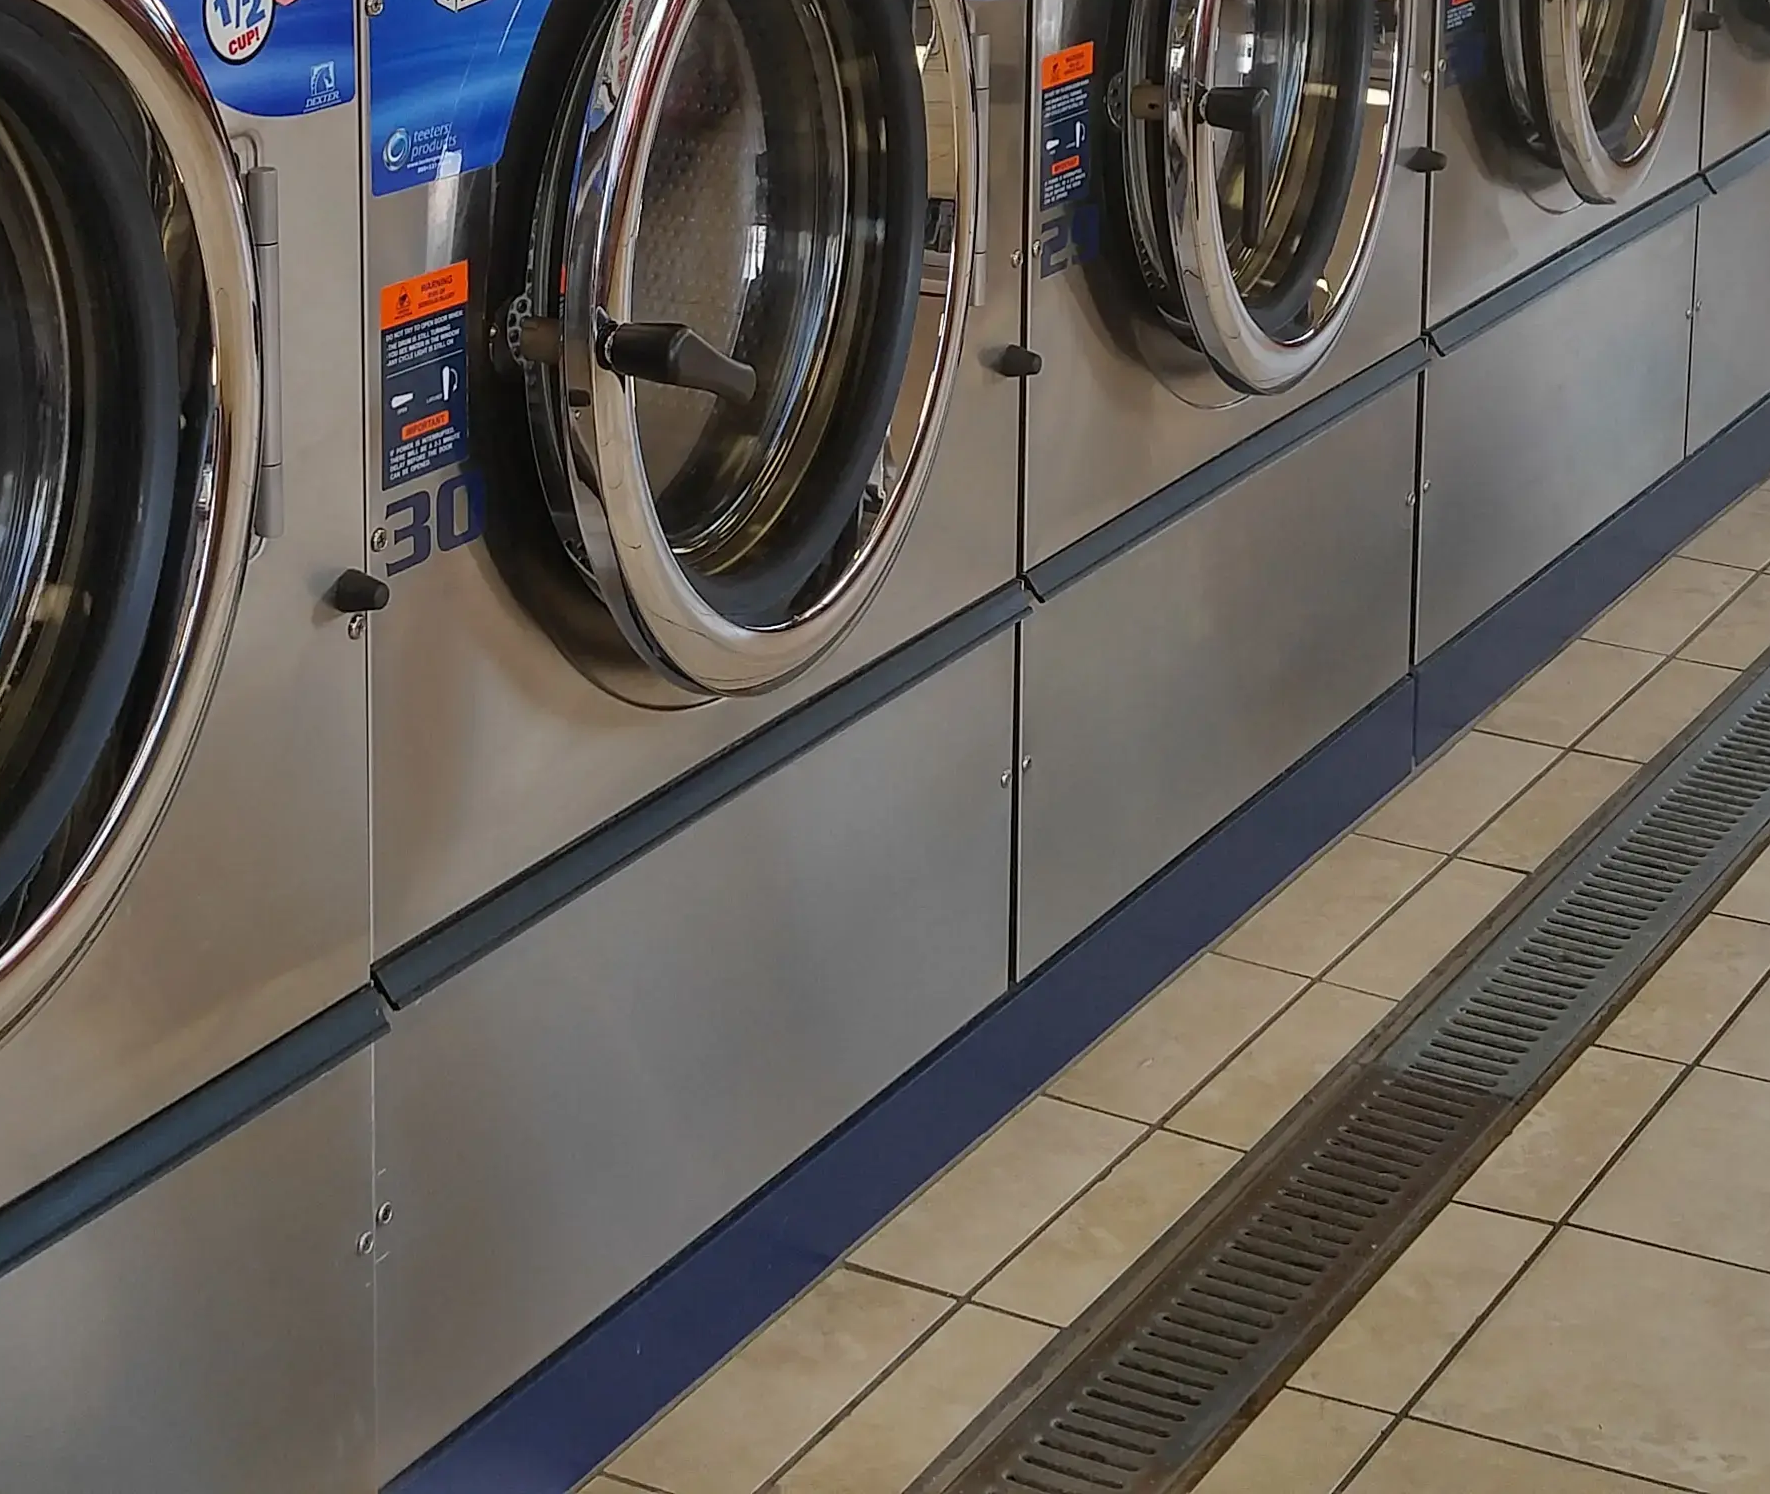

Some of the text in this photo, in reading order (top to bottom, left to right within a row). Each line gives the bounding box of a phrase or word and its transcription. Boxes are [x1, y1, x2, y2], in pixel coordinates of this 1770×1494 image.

[228, 26, 261, 57] CUP!
[305, 90, 341, 109] DEXTER
[411, 135, 457, 162] produts
[385, 471, 486, 579] 30
